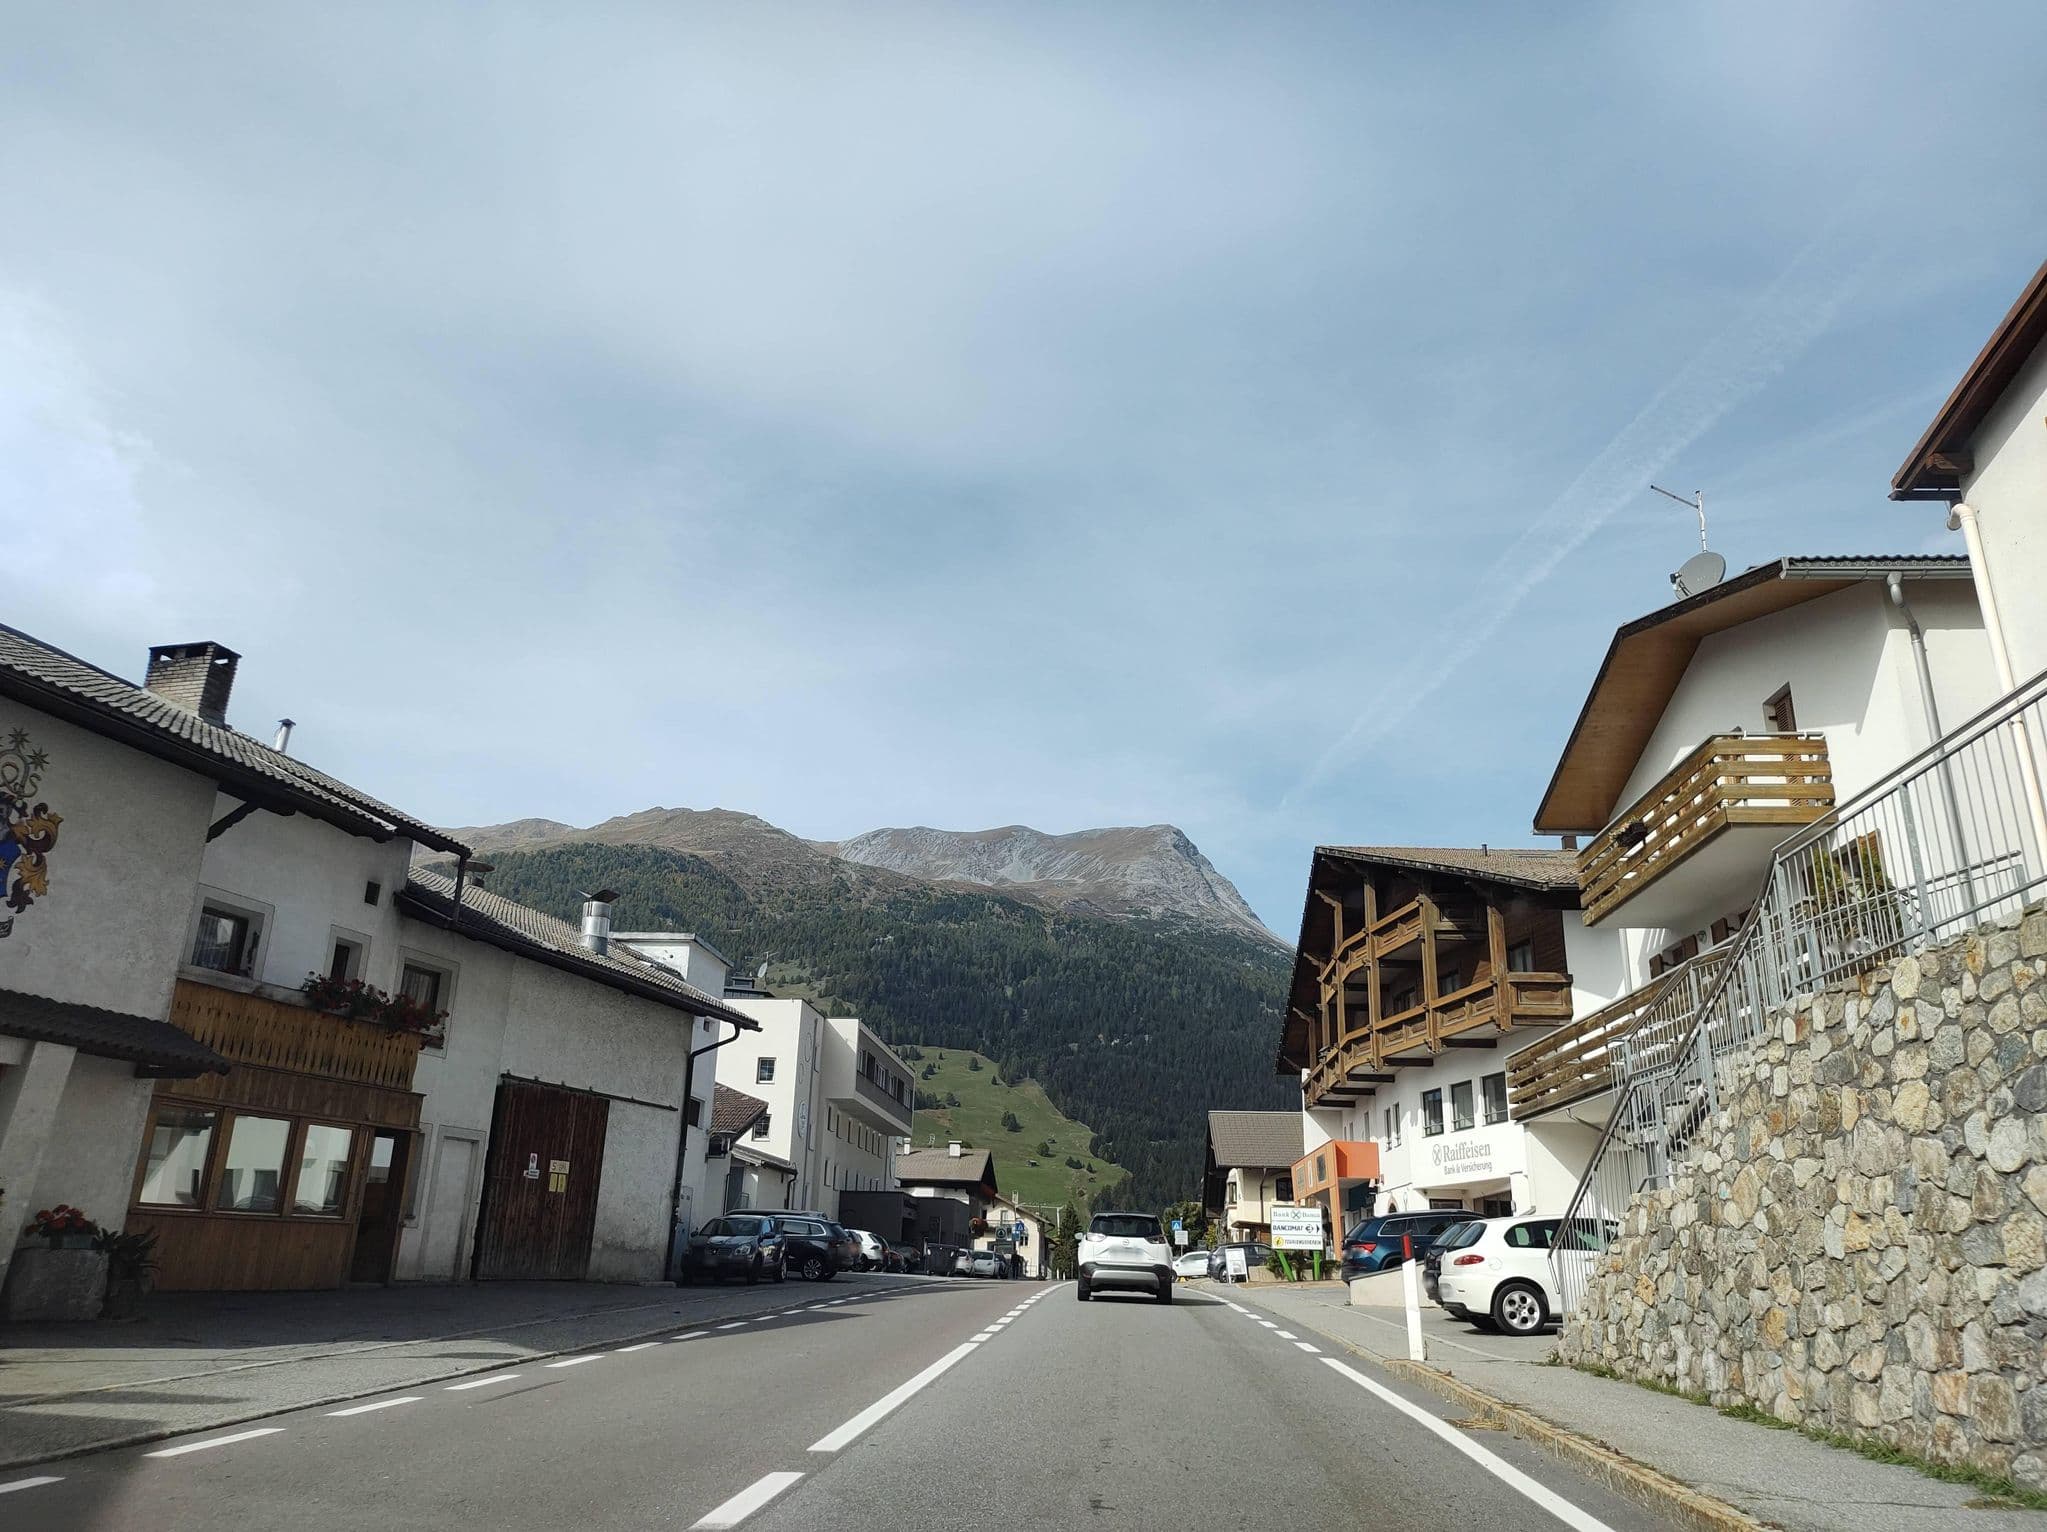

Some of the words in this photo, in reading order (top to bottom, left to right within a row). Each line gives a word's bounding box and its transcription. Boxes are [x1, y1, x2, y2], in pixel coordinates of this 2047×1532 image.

[1443, 1140, 1491, 1162] Raiffeisen
[1444, 1165, 1455, 1175] Bank
[1461, 1161, 1492, 1173] Versicherung
